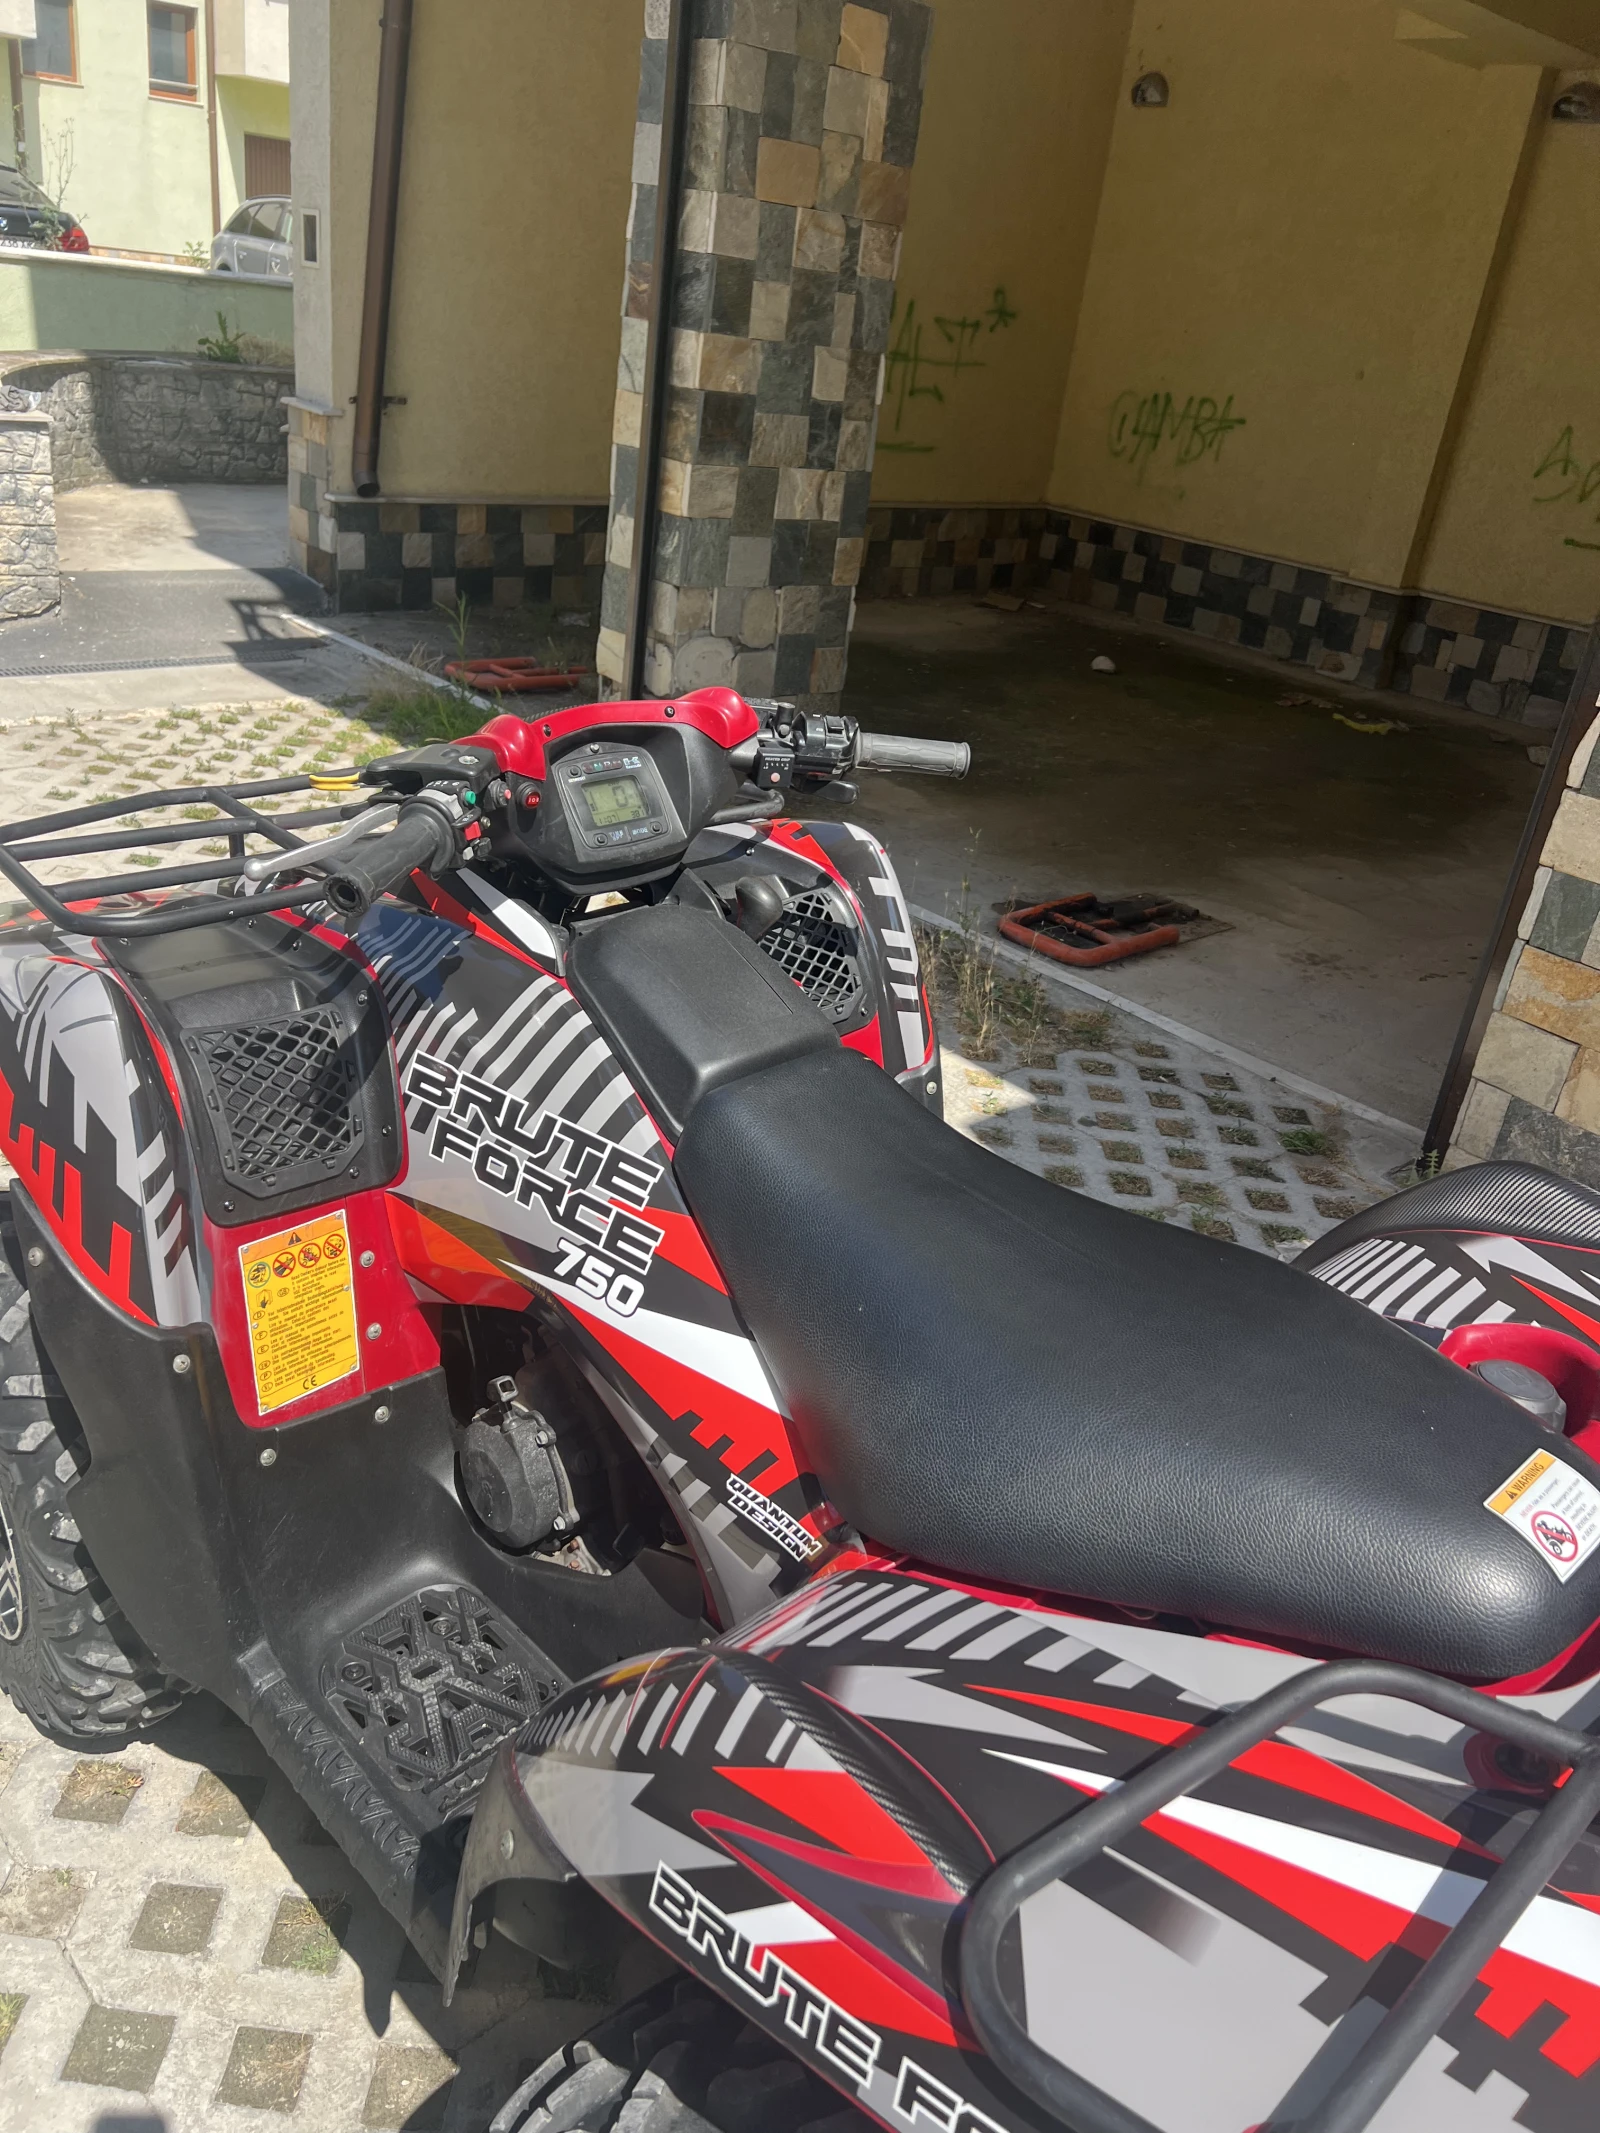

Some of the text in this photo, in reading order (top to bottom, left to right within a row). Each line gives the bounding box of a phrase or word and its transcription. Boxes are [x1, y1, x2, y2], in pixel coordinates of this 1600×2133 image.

[405, 1049, 665, 1210] BRUTE
[429, 1115, 665, 1275] FORCE
[553, 1238, 645, 1317] 750
[726, 1473, 822, 1556] QUANTUM
[1512, 1462, 1545, 1493] WARNING
[727, 1492, 808, 1562] DESIGN
[648, 1860, 882, 2088] BRUTE
